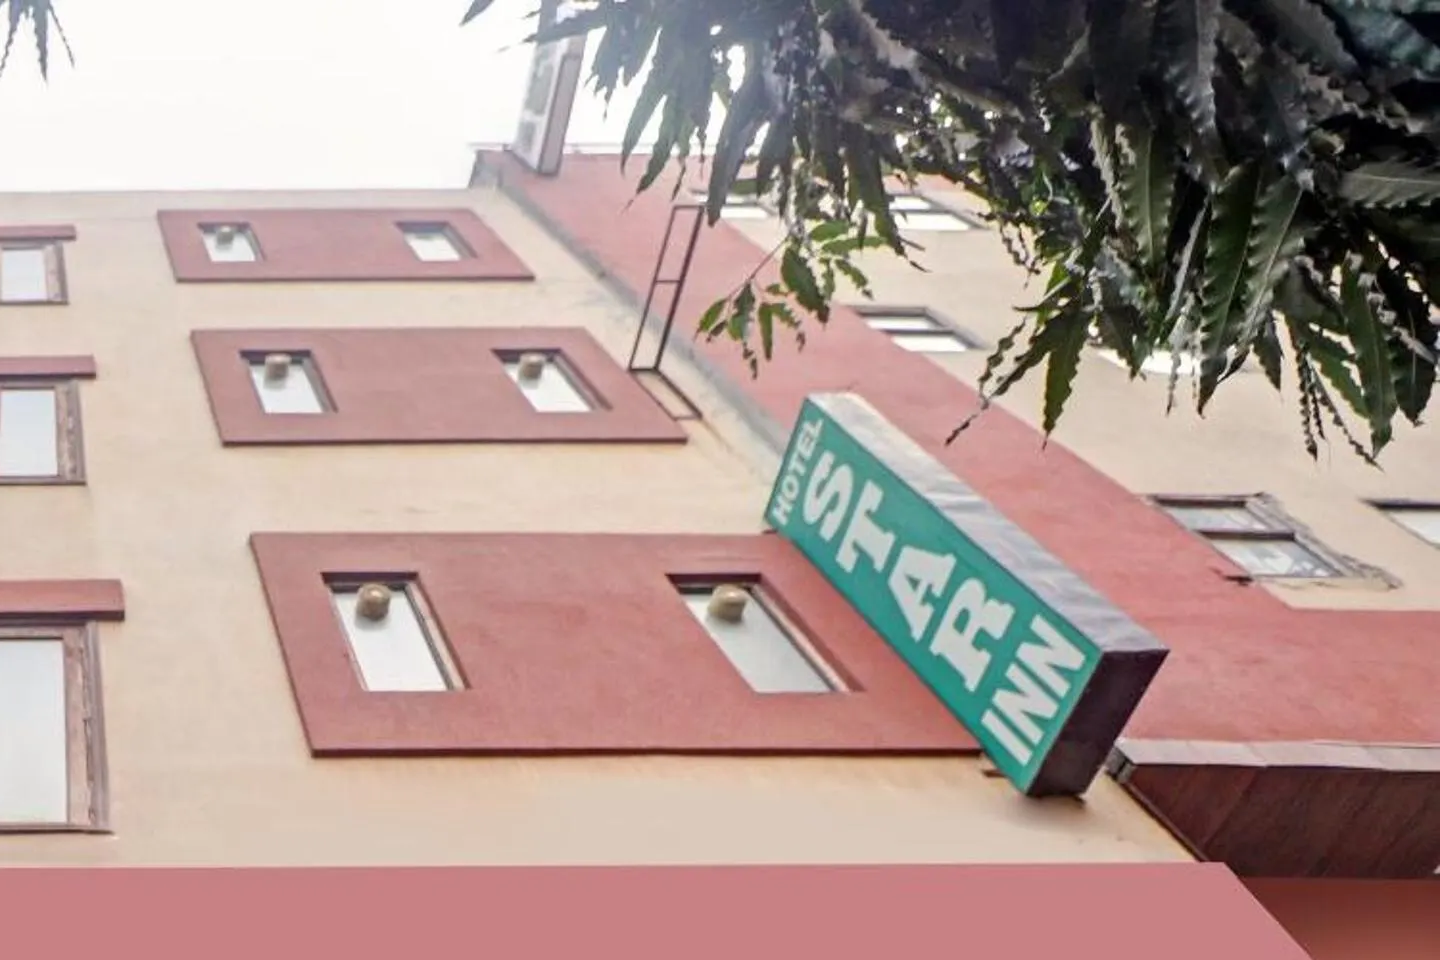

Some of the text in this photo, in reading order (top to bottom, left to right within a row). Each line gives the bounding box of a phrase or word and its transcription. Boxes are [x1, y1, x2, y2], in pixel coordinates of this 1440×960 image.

[771, 418, 824, 526] HOTEL
[802, 450, 1015, 692] STAR
[981, 614, 1086, 766] INN
